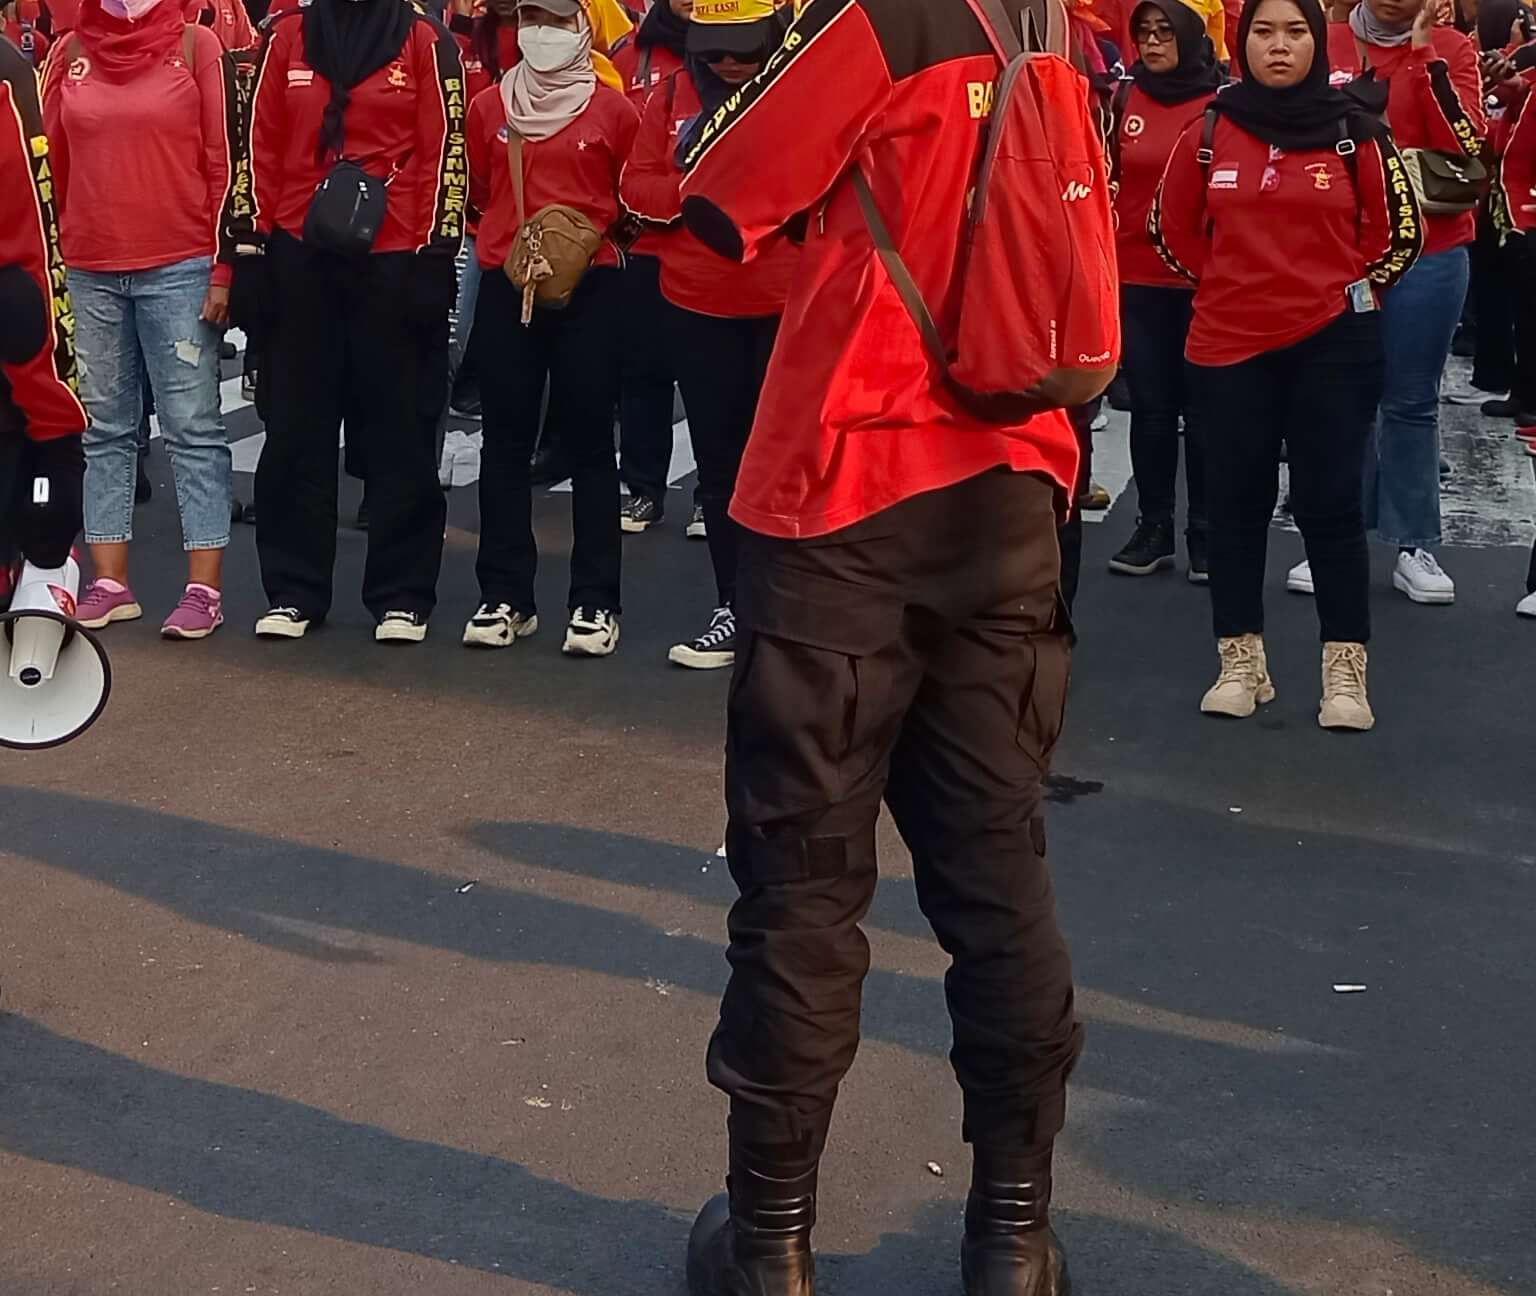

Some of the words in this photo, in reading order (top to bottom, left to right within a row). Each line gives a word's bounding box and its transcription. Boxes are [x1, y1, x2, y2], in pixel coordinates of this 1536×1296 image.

[444, 78, 465, 171] BARISAN
[30, 135, 66, 289] BARISAN
[440, 172, 467, 237] MERAH
[1387, 156, 1416, 240] BARISAN
